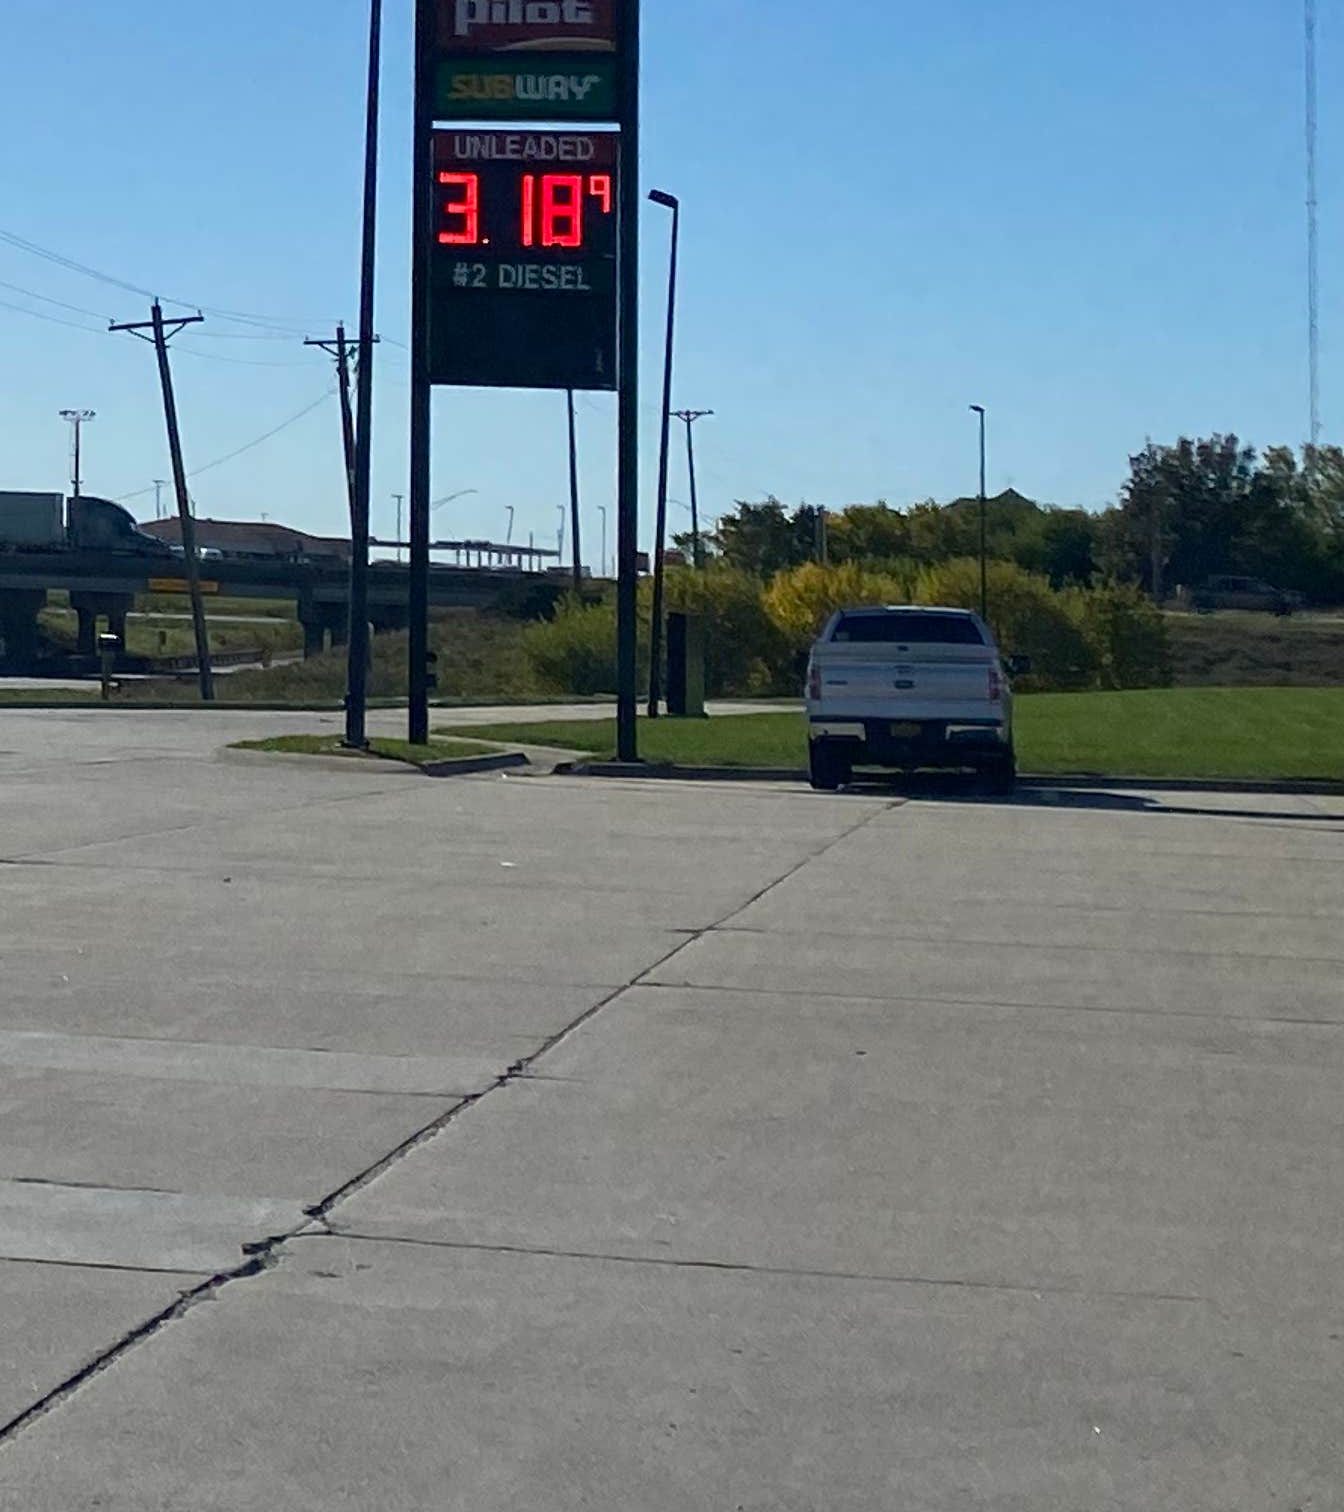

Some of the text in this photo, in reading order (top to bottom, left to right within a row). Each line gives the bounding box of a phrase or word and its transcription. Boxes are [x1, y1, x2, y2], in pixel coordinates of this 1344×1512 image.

[448, 74, 601, 101] SUBWAY
[454, 135, 595, 161] UNLEADED
[452, 262, 592, 290] #2 DIESEL
